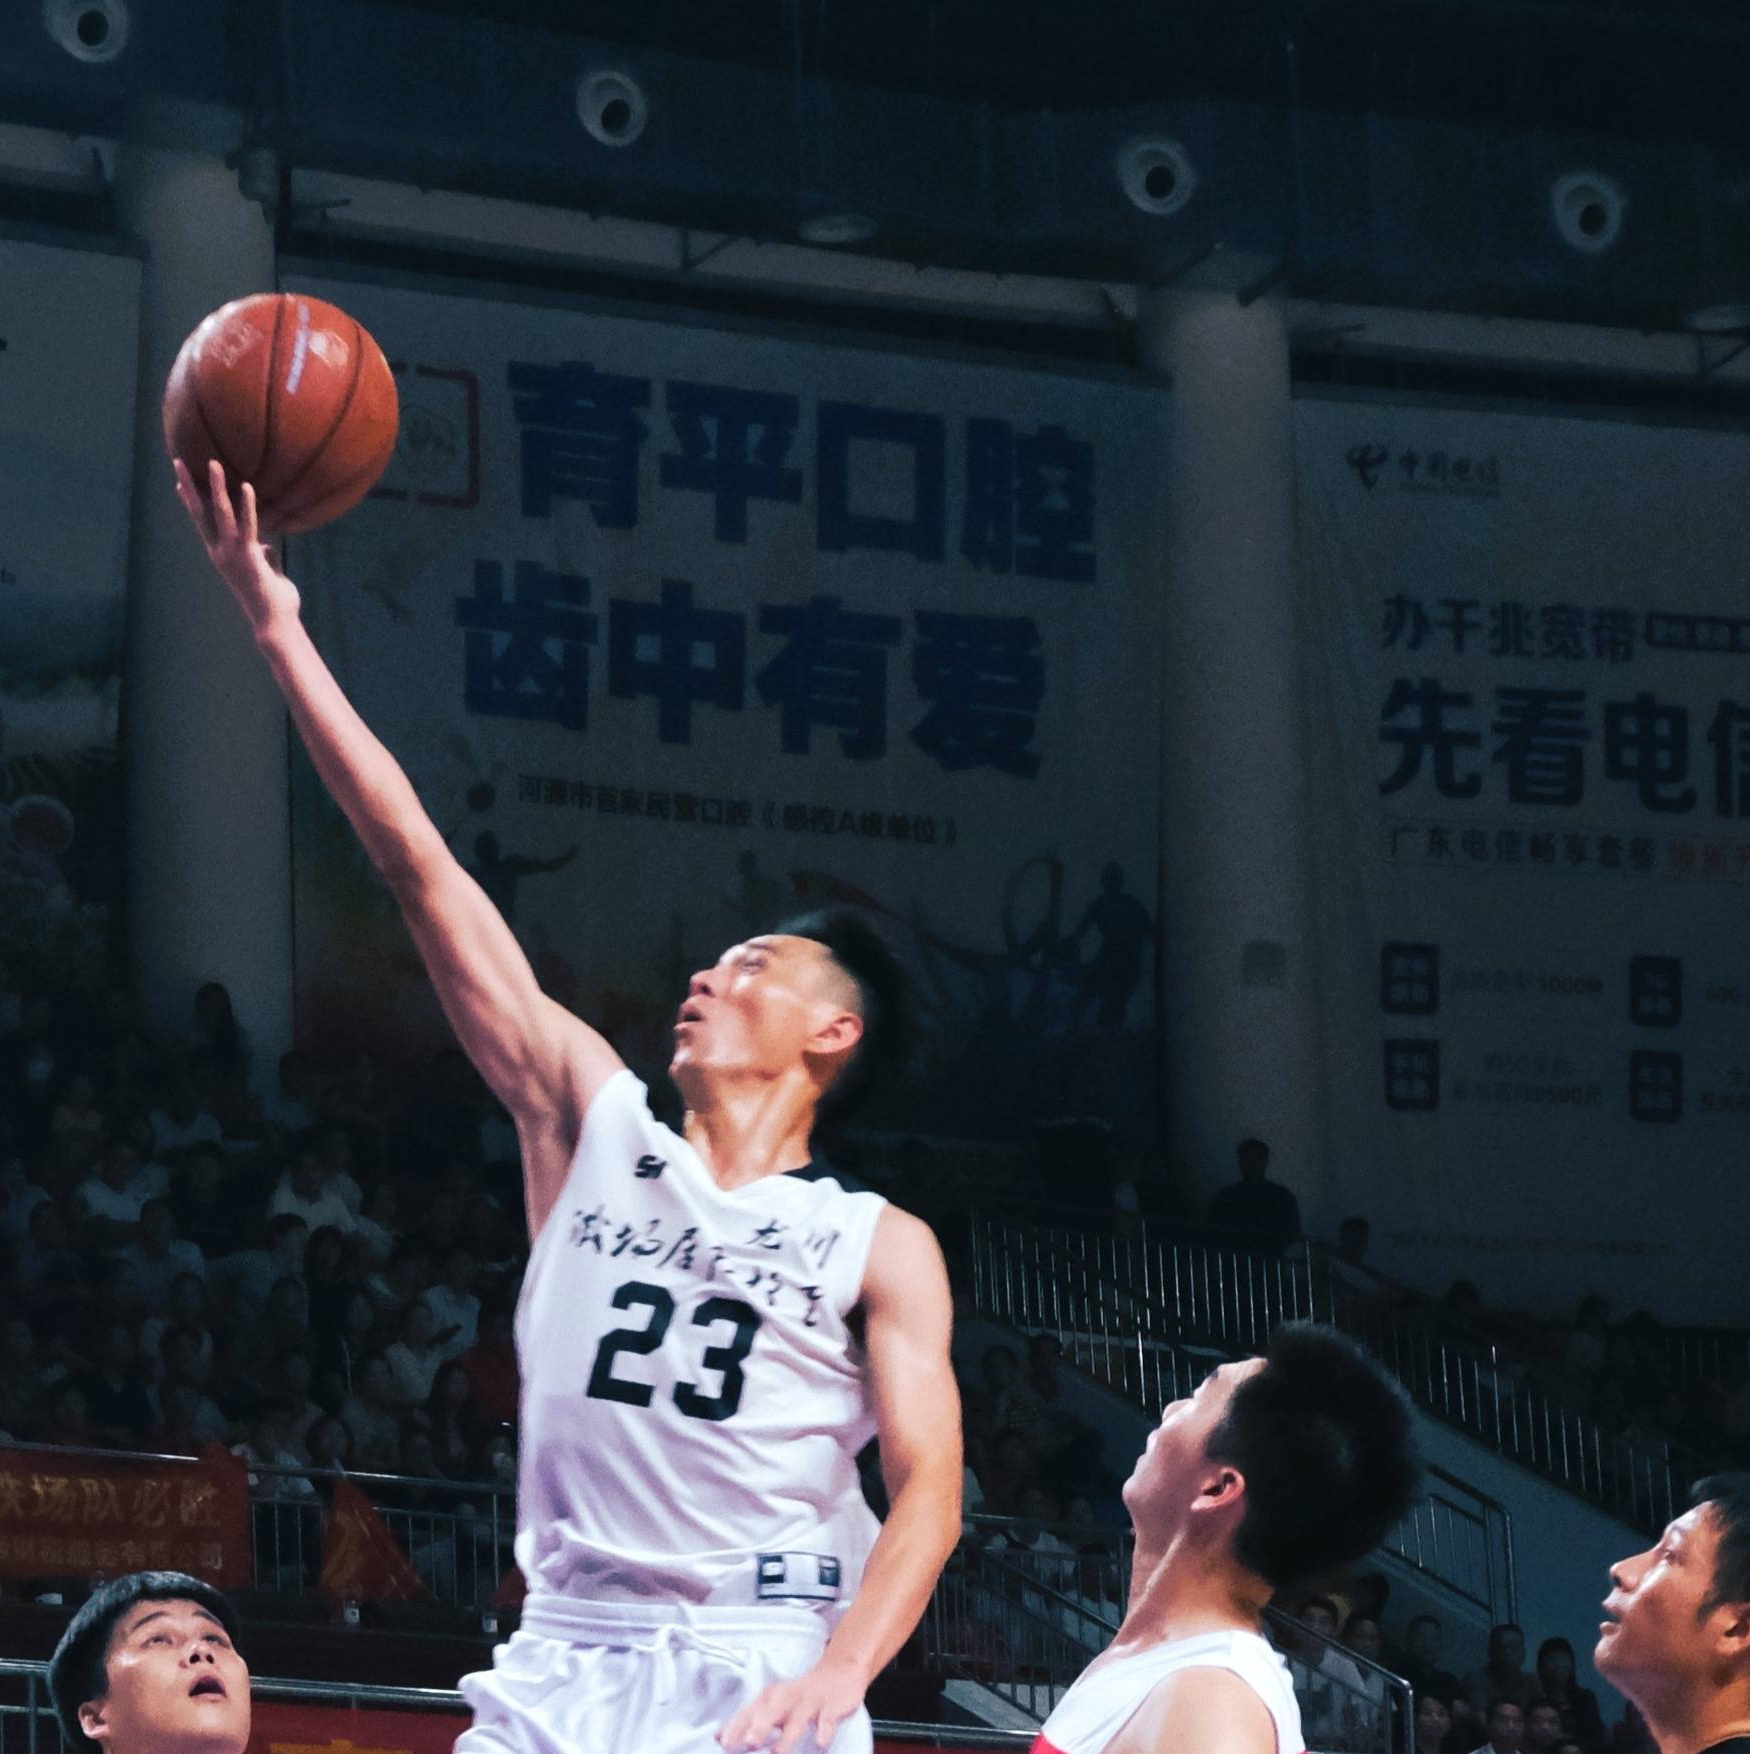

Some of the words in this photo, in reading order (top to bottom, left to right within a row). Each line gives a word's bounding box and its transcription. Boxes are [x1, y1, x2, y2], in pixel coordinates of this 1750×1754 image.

[507, 361, 1097, 584] 育平口腔
[456, 559, 1045, 780] 齿中有爱
[586, 1280, 762, 1422] 23
